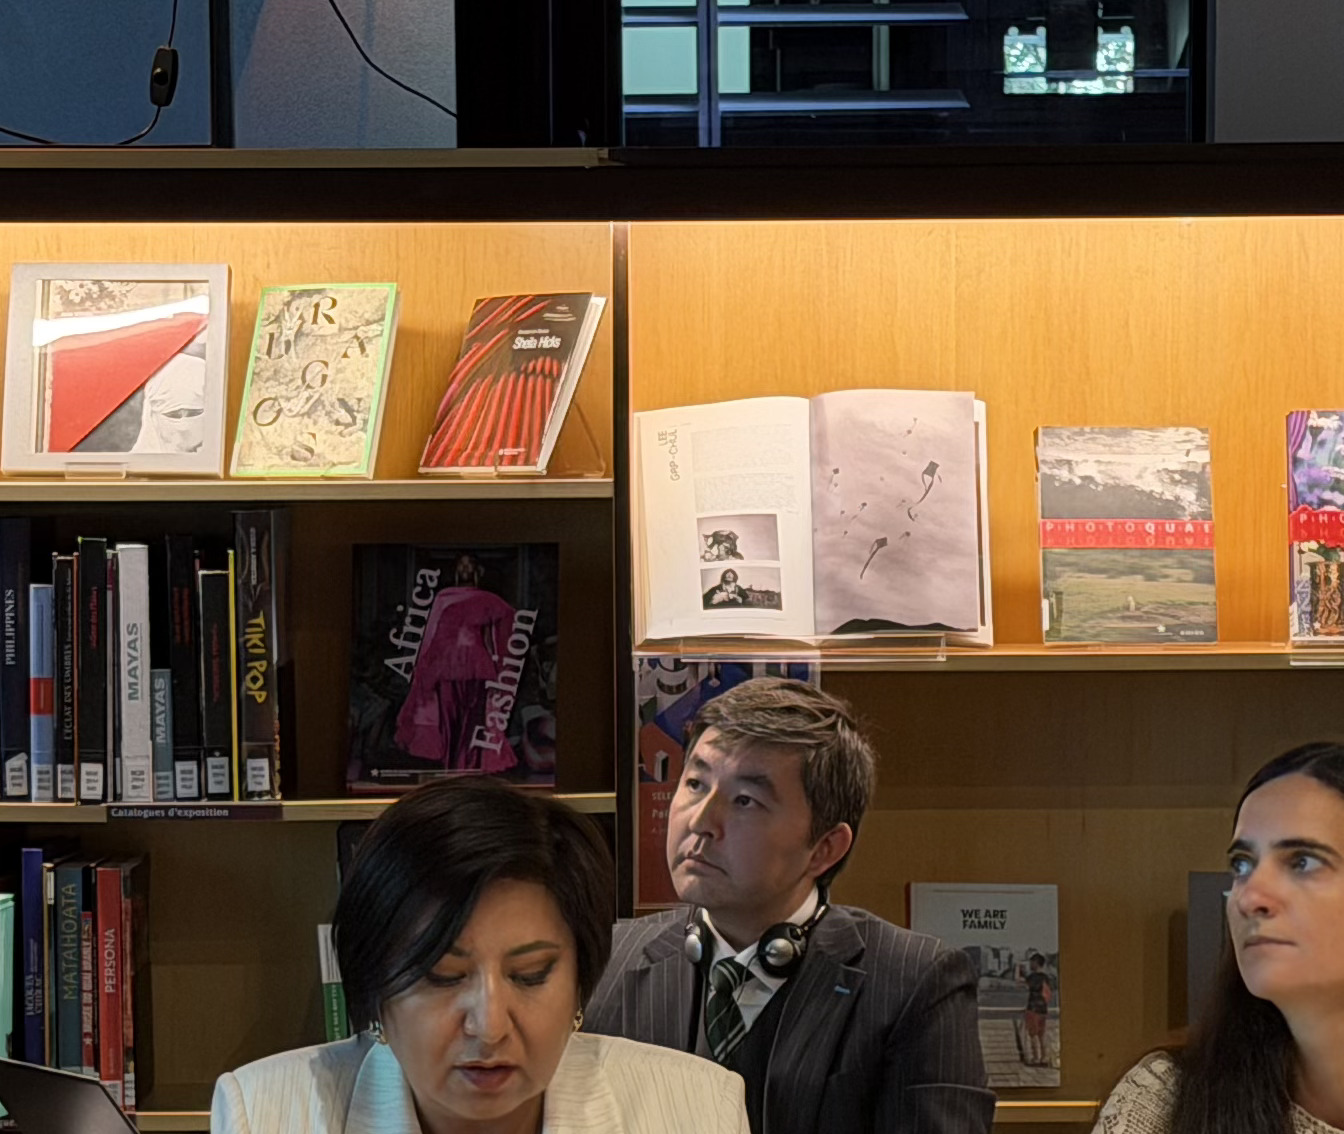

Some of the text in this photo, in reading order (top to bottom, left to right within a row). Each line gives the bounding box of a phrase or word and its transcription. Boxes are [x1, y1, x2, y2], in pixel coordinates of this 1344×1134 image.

[513, 336, 561, 349] Sheila Hicks
[658, 430, 668, 446] LEE
[5, 588, 16, 666] PHILIPPINES
[243, 609, 269, 704] TIKI POP
[384, 568, 441, 684] Africa
[126, 622, 140, 702] MAYAS
[468, 607, 539, 754] Fashion
[156, 676, 172, 745] MAYAS
[111, 807, 230, 820] Catalogues d'exposition
[62, 882, 78, 1001] MATAHOATA
[961, 909, 1007, 919] WE ARE
[962, 920, 1006, 930] FAMILY
[104, 928, 116, 994] PERSONA
